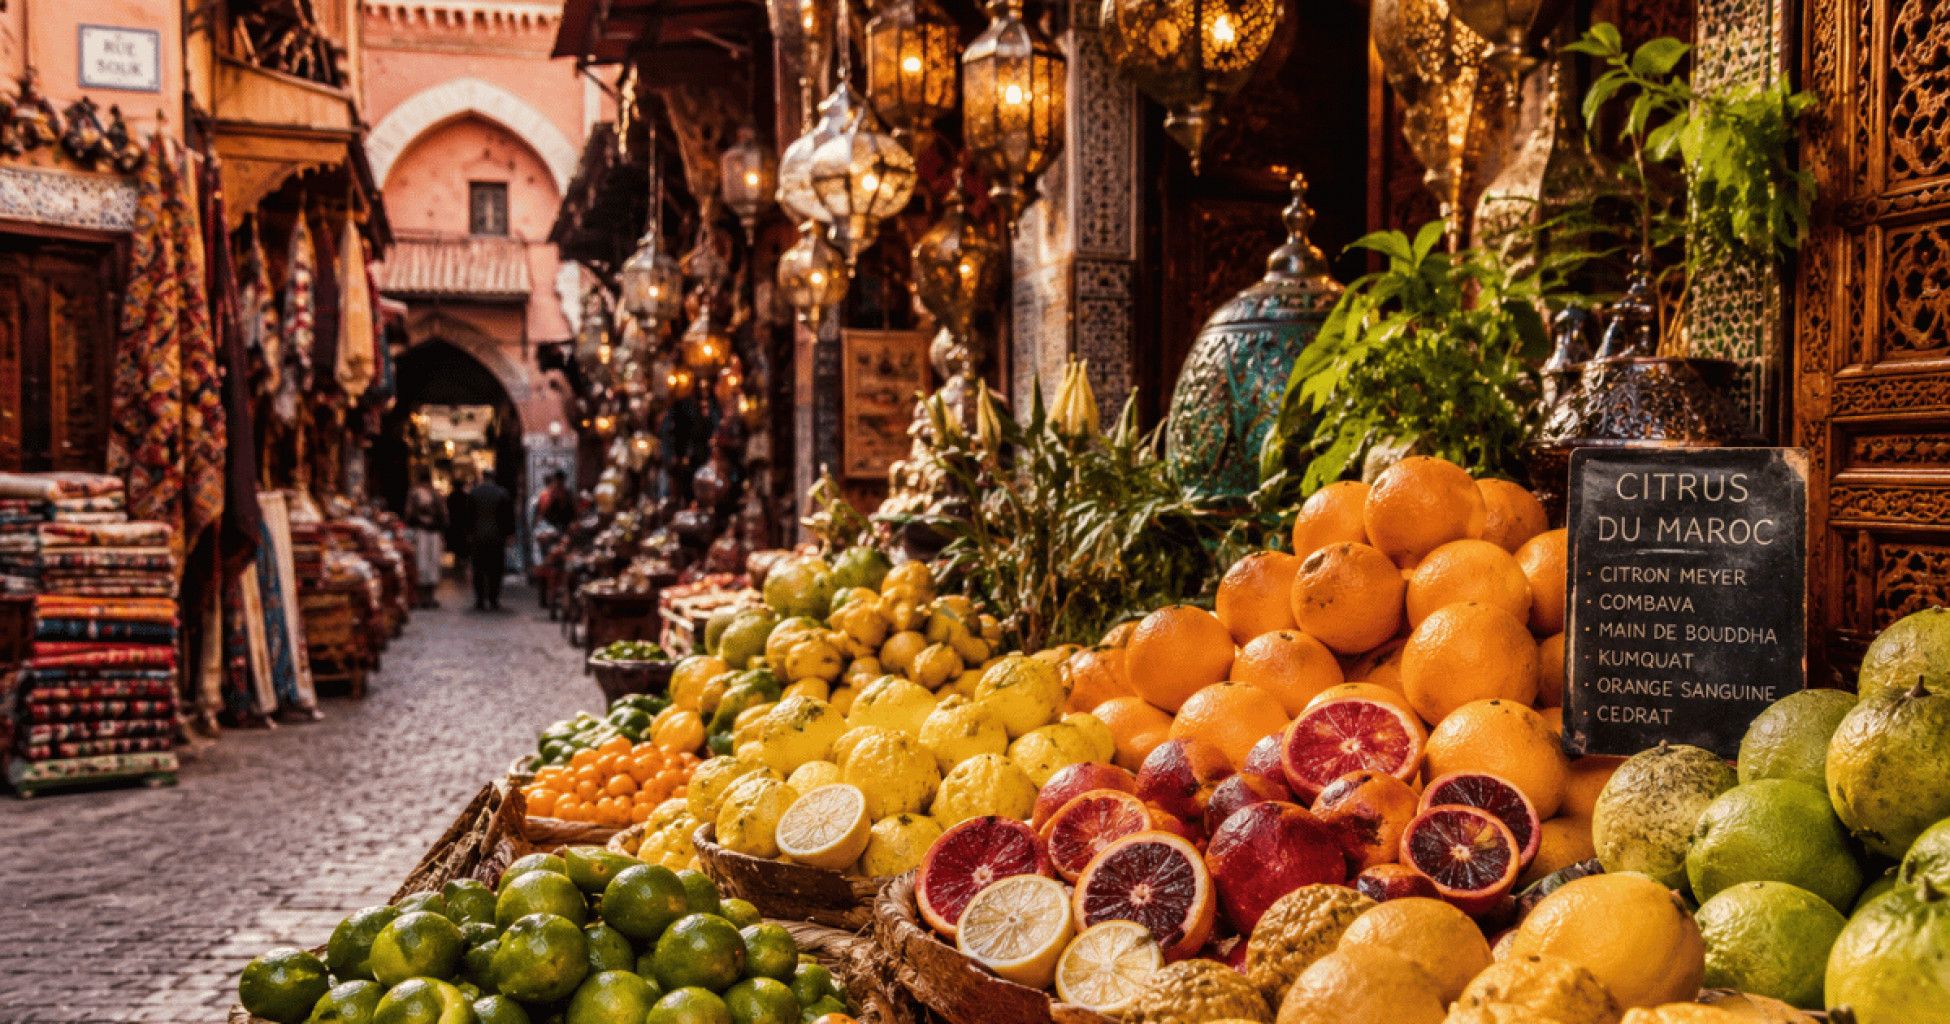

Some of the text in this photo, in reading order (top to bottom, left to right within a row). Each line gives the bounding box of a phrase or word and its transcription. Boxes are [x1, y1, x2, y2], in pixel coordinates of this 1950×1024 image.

[1616, 472, 1749, 502] CITRUS
[1598, 516, 1774, 545] DU MAROC
[1600, 566, 1747, 586] CITRON MEYER
[1599, 594, 1695, 613] COMBAVA
[1599, 622, 1778, 645] MAIN DE BOUDDHA
[1598, 650, 1695, 670] KUMQUAT
[1597, 678, 1777, 702] ORANGE SANGUINE
[1596, 705, 1673, 725] CEDRAT
